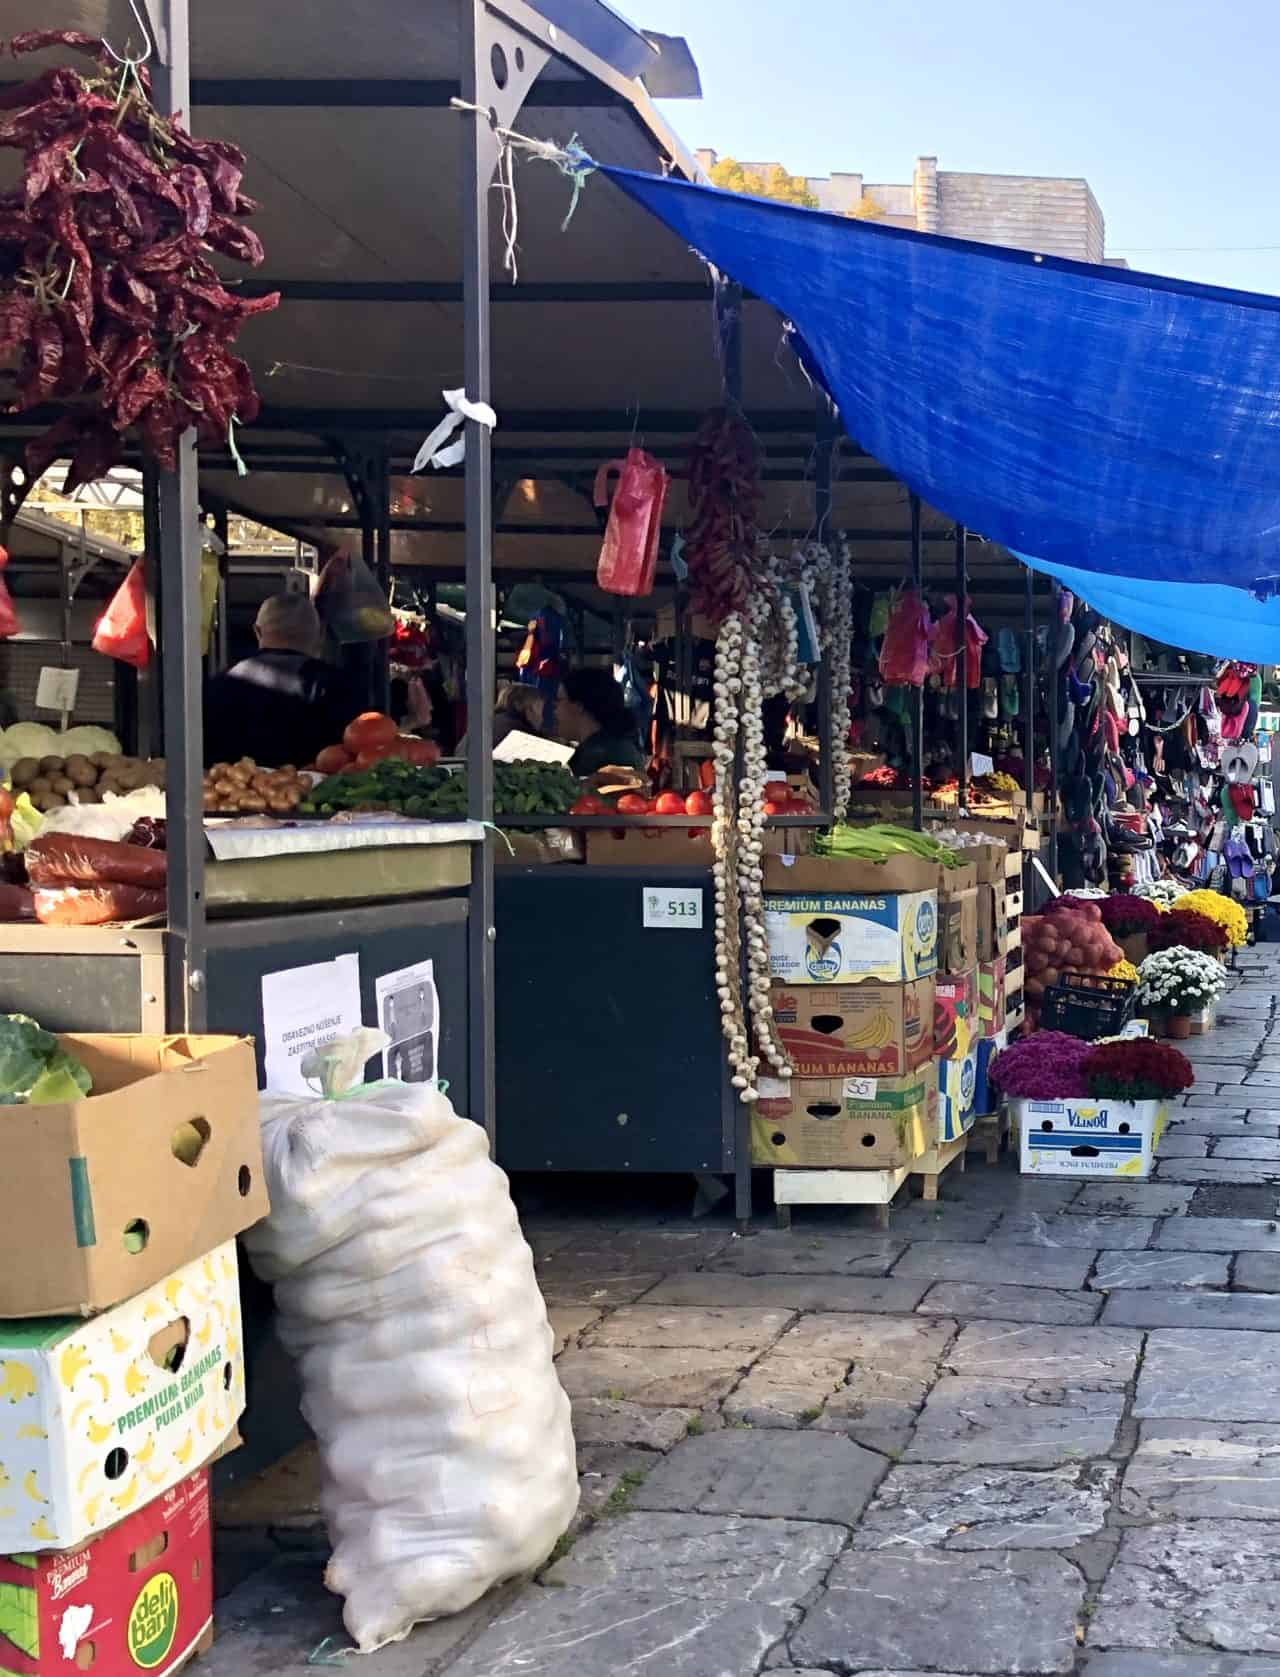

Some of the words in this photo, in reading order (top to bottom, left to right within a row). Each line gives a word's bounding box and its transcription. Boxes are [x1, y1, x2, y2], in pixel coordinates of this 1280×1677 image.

[668, 901, 697, 916] 513
[763, 899, 820, 911] PREMIUM
[824, 899, 886, 911] BANANAS
[828, 1062, 895, 1074] BANANAS
[1067, 1108, 1109, 1129] BONITA
[117, 1383, 178, 1434] PREMIUM
[181, 1344, 222, 1392] BANANAS
[155, 1401, 183, 1431] PURA
[184, 1383, 204, 1410] VIDA
